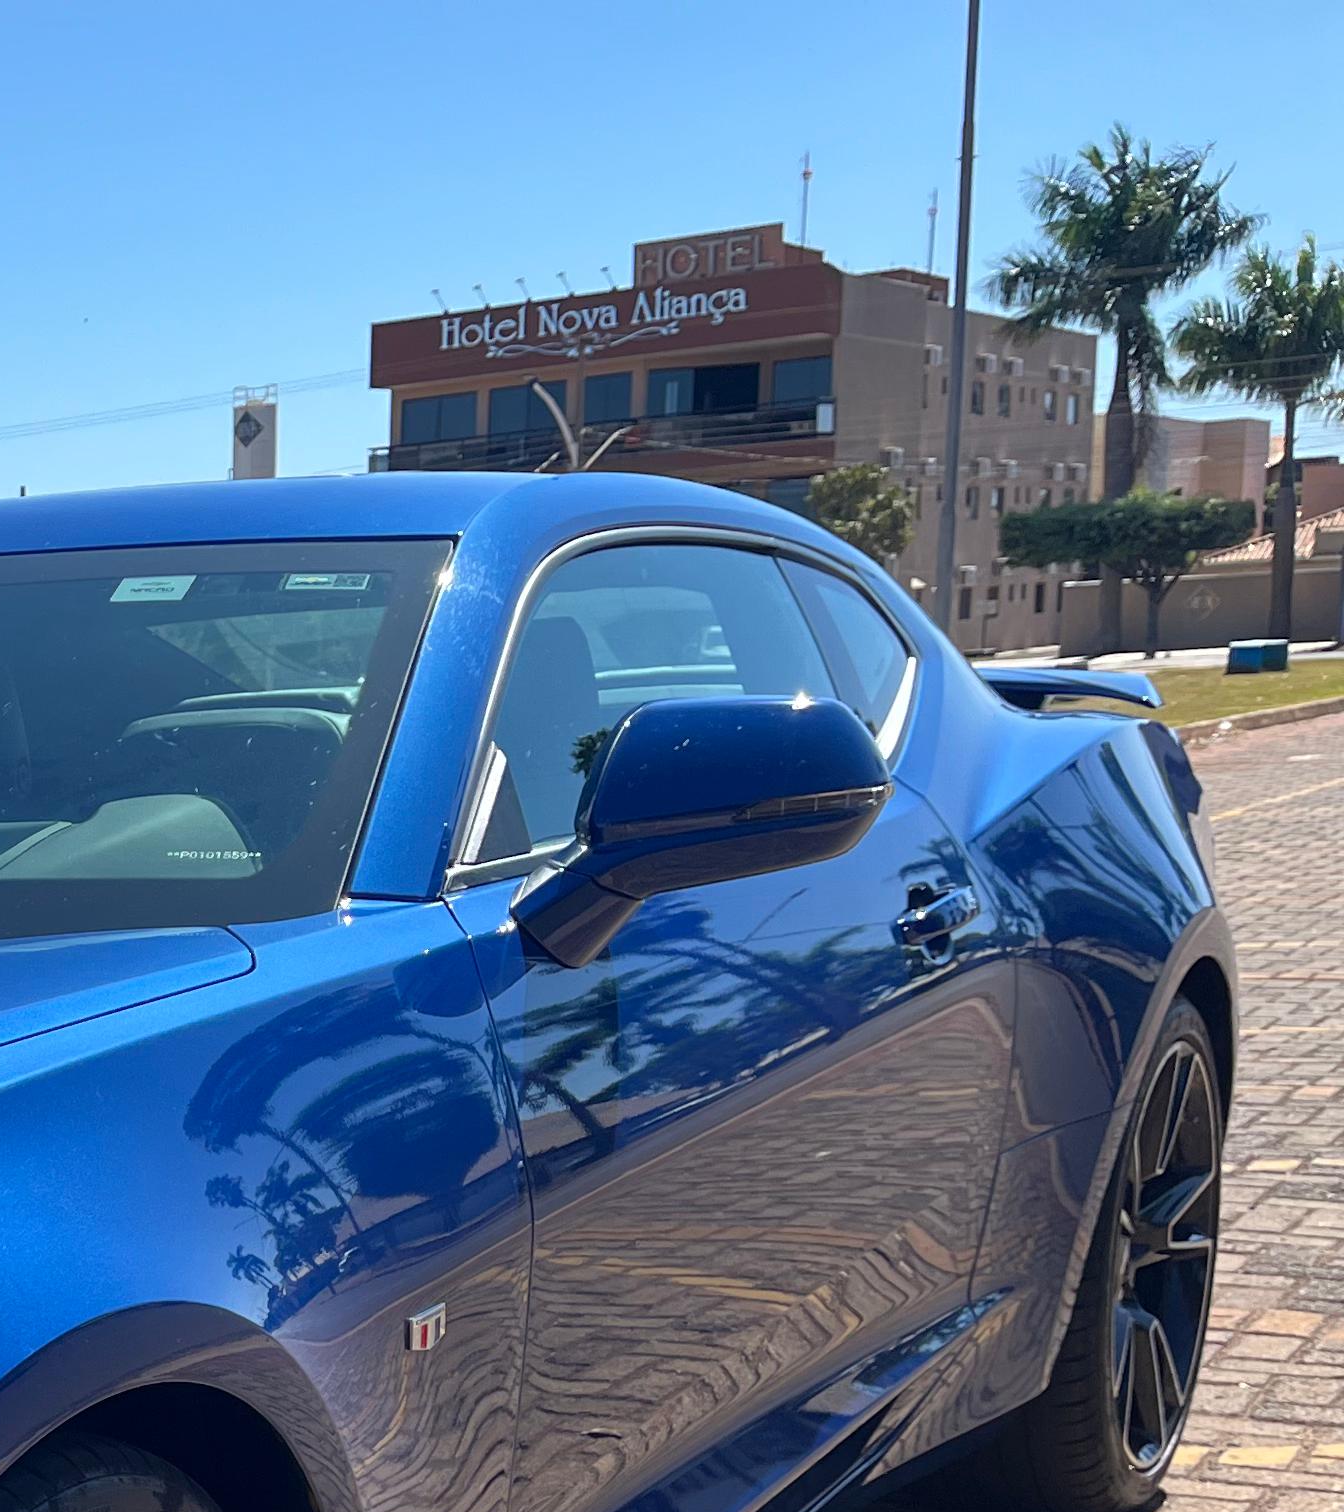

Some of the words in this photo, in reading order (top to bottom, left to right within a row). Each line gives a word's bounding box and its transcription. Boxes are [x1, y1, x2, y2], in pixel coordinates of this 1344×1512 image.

[637, 234, 774, 287] HOTEL
[440, 304, 526, 350] Hotel
[538, 302, 620, 338] Nova
[630, 285, 749, 325] Aliança
